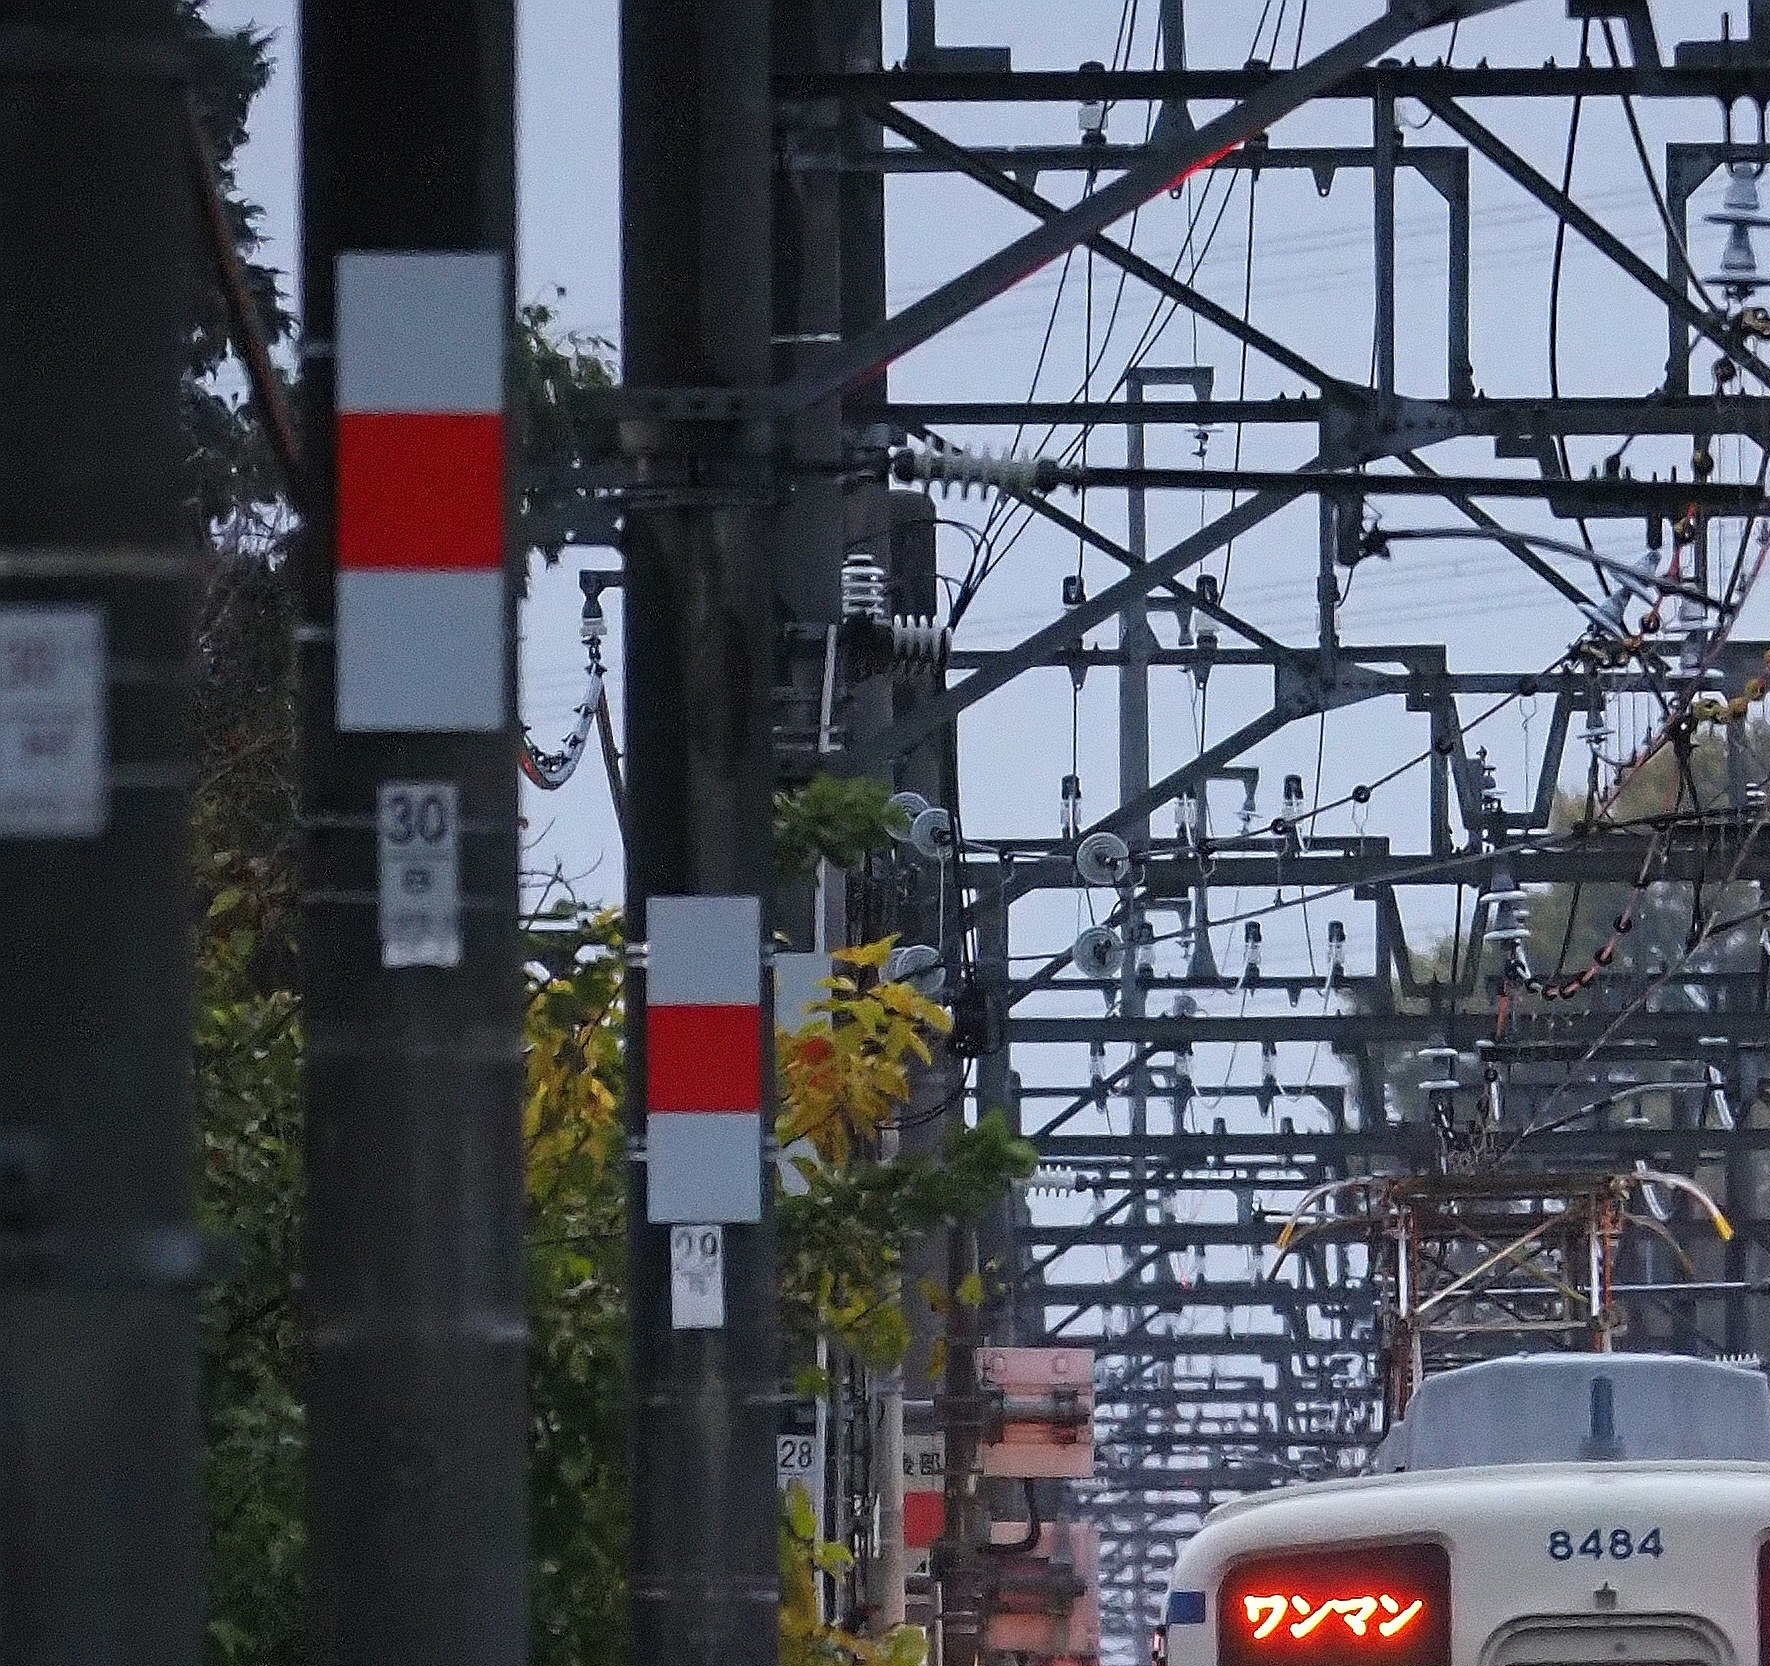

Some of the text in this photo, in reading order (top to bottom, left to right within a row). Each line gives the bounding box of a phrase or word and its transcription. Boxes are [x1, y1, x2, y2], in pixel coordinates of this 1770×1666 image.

[385, 793, 447, 843] 30
[780, 1440, 812, 1468] 28
[1549, 1527, 1664, 1560] 8484
[1243, 1594, 1423, 1639] ワンマン
